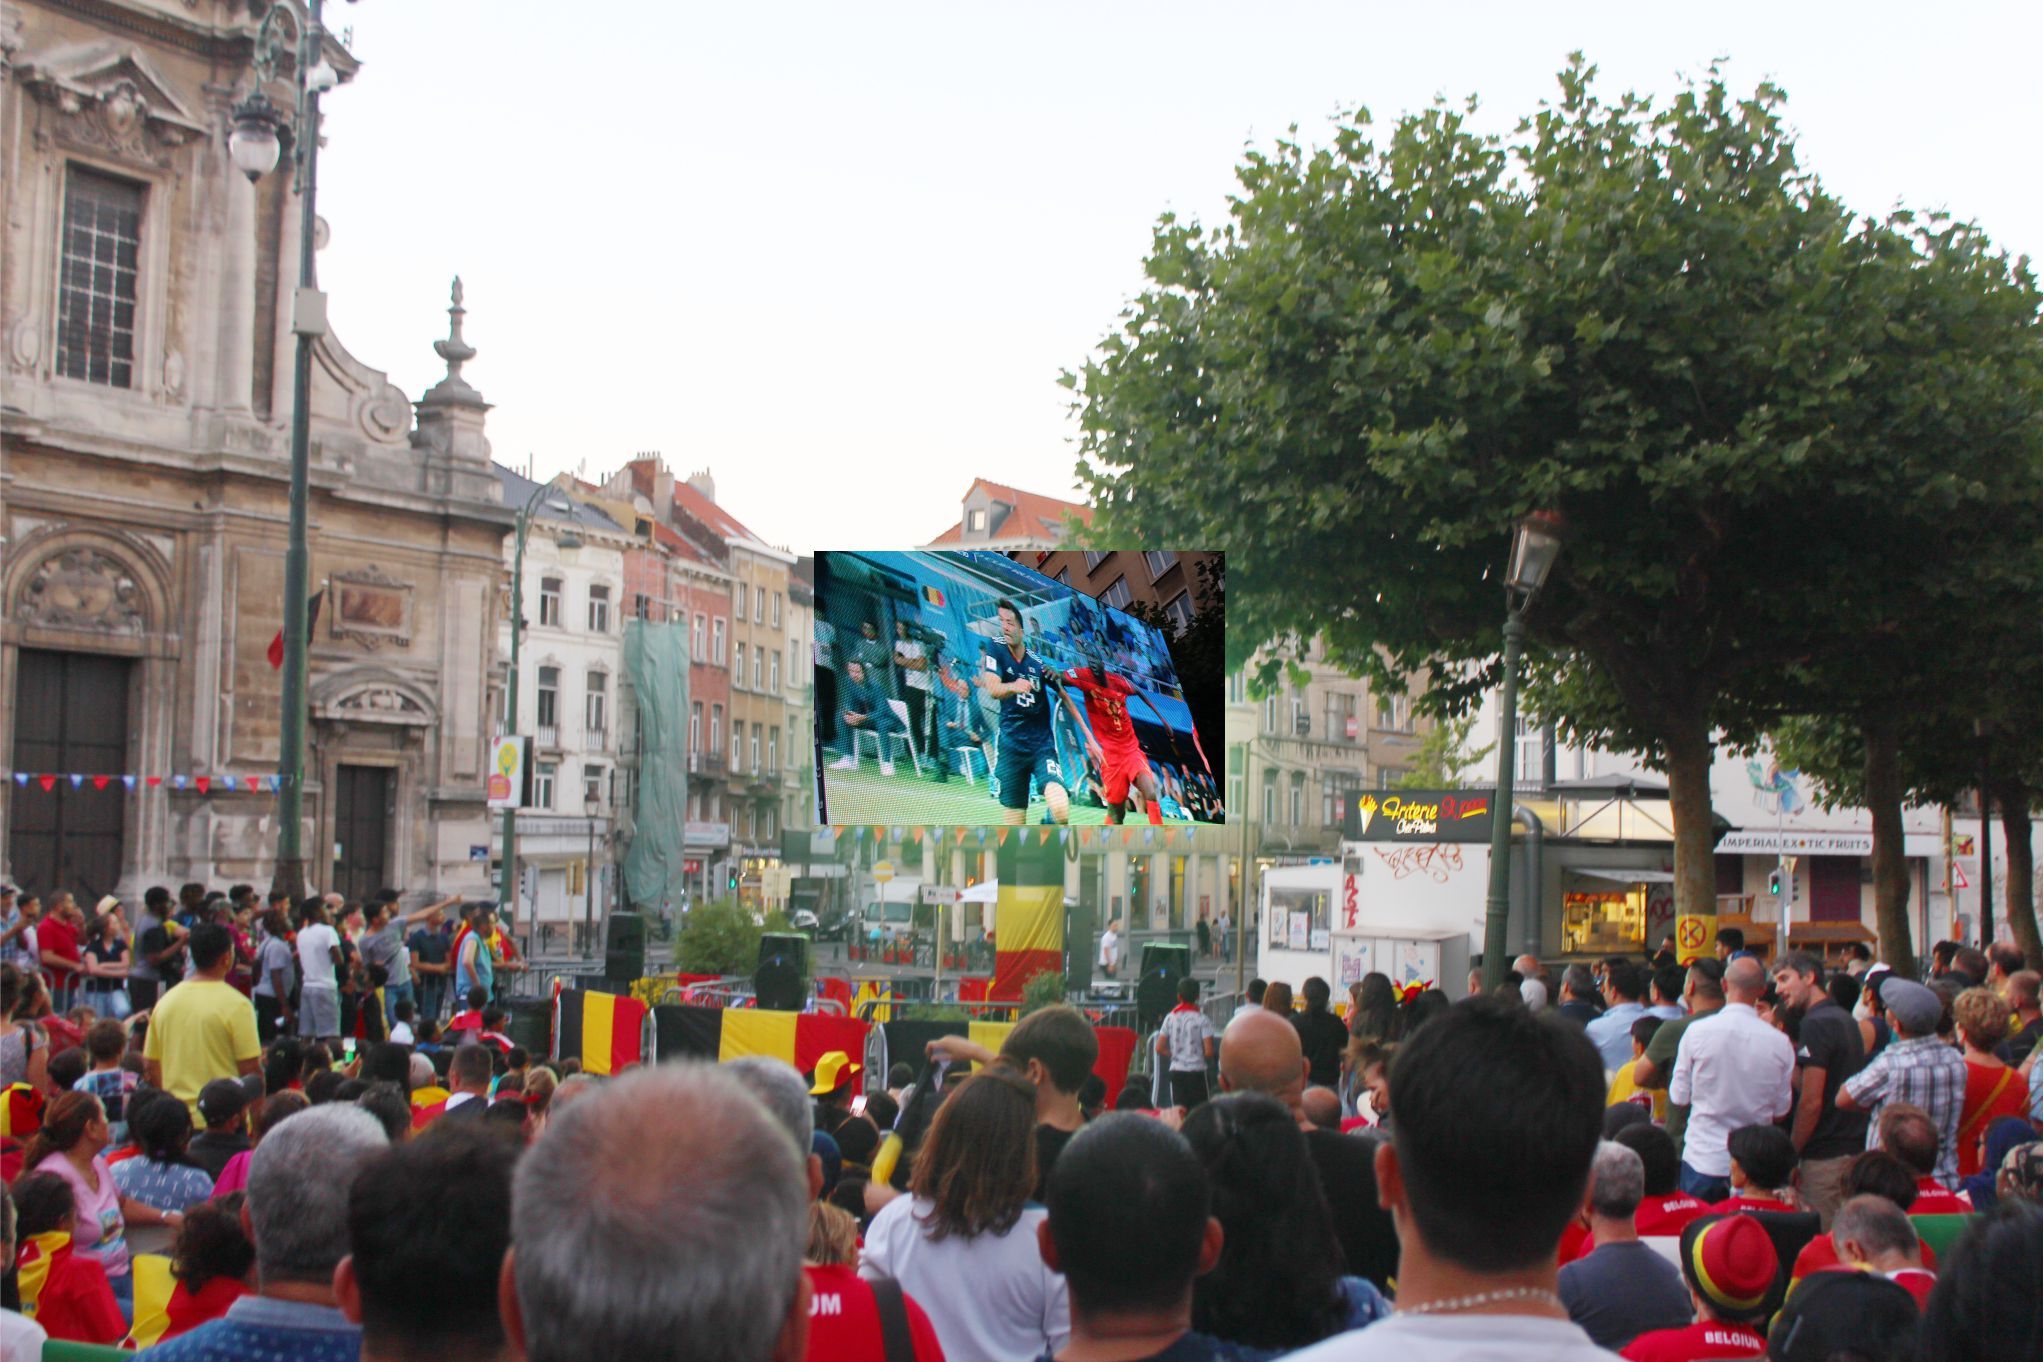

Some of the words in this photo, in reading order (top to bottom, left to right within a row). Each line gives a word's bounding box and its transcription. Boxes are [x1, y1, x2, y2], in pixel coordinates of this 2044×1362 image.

[1382, 796, 1438, 820] Friterie
[1723, 838, 1777, 848] IMPERIAL
[1828, 838, 1870, 849] FRUITS
[1704, 1330, 1761, 1350] BELGIUM
